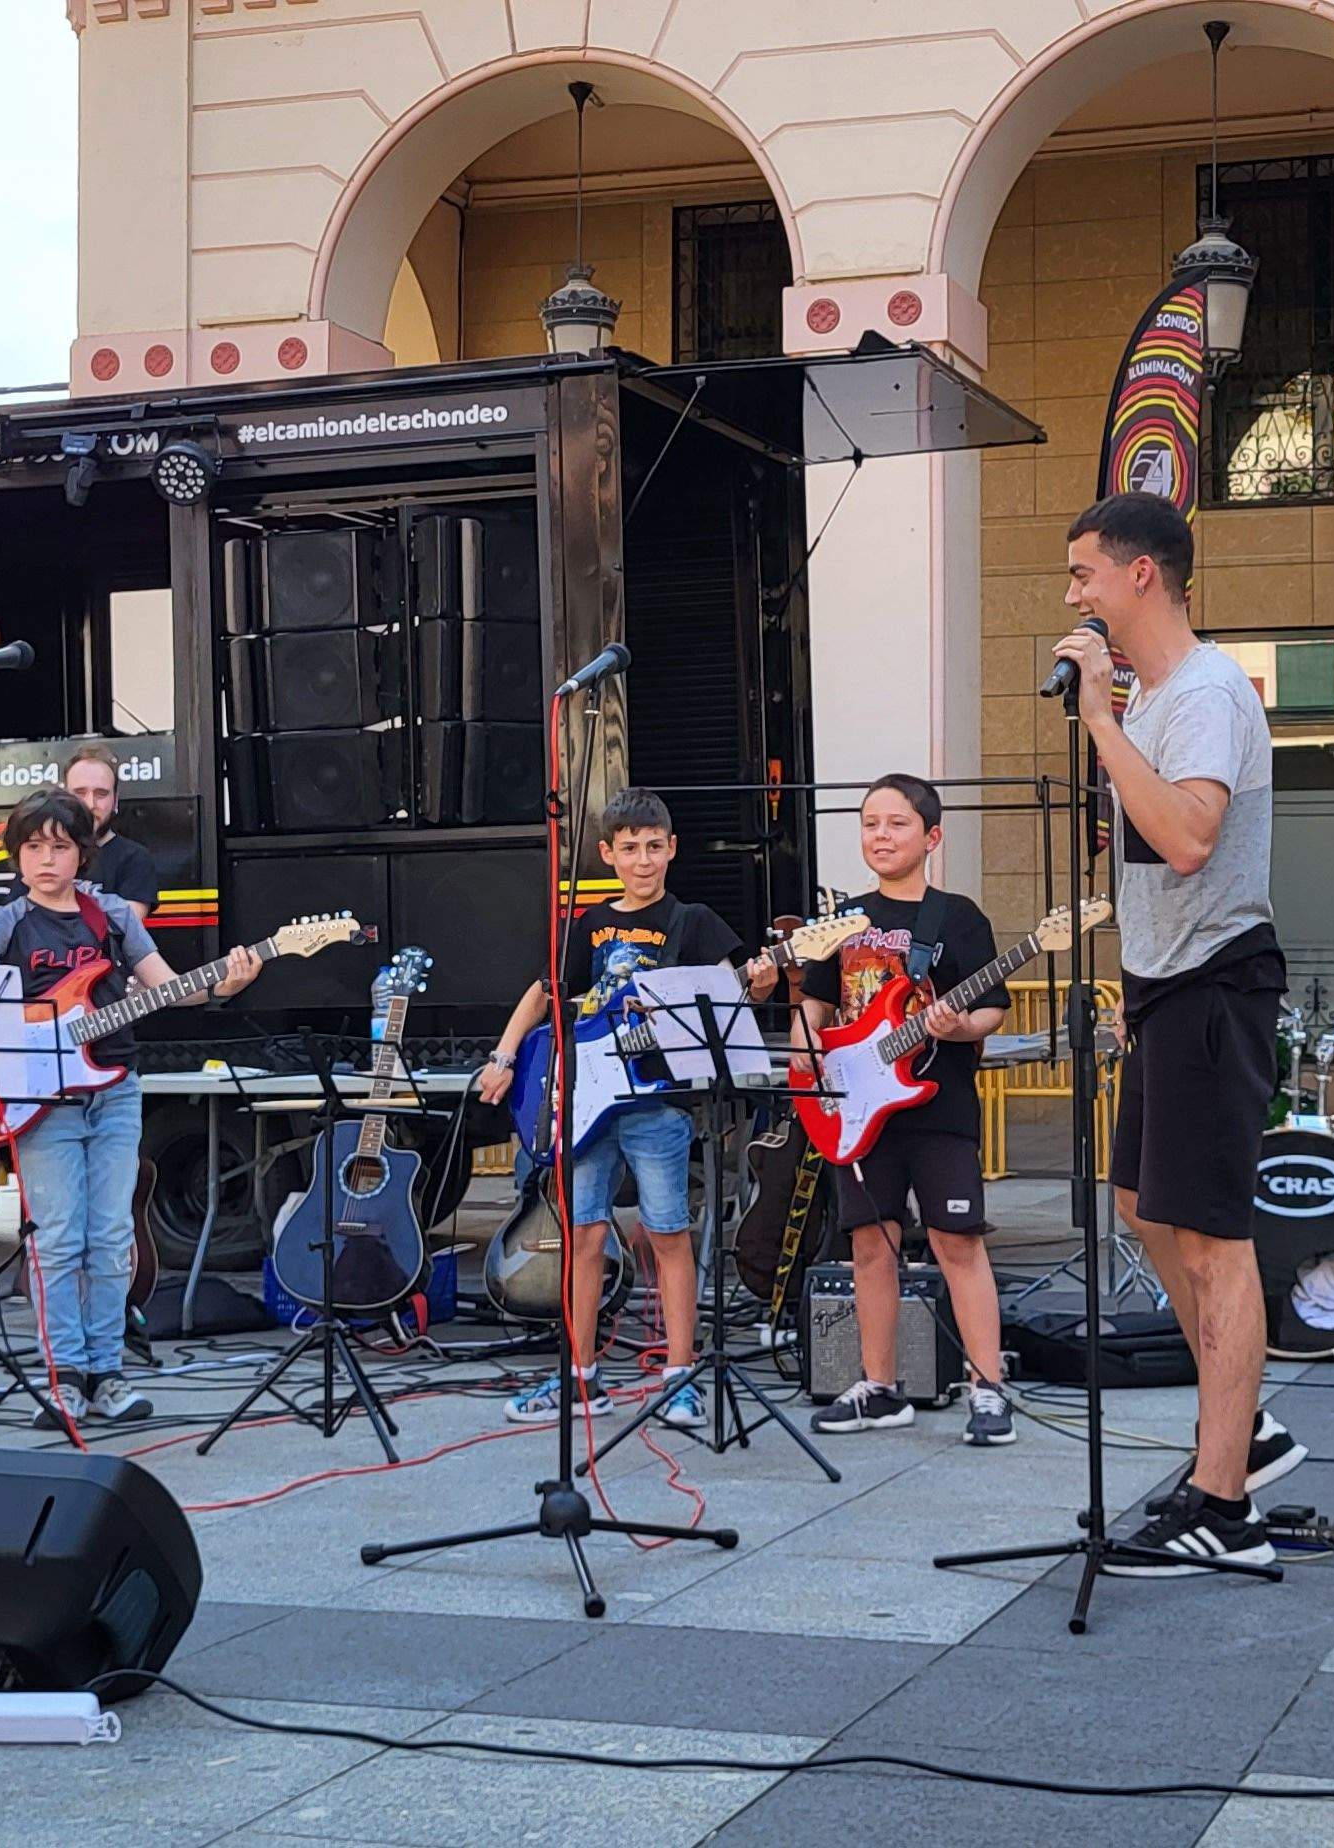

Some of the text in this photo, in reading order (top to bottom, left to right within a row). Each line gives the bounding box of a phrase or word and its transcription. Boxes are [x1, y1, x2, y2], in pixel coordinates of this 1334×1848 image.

[1155, 313, 1198, 334] SONIDO
[237, 404, 508, 443] #elcamiondelcachondeo
[1113, 671, 1136, 684] ANT
